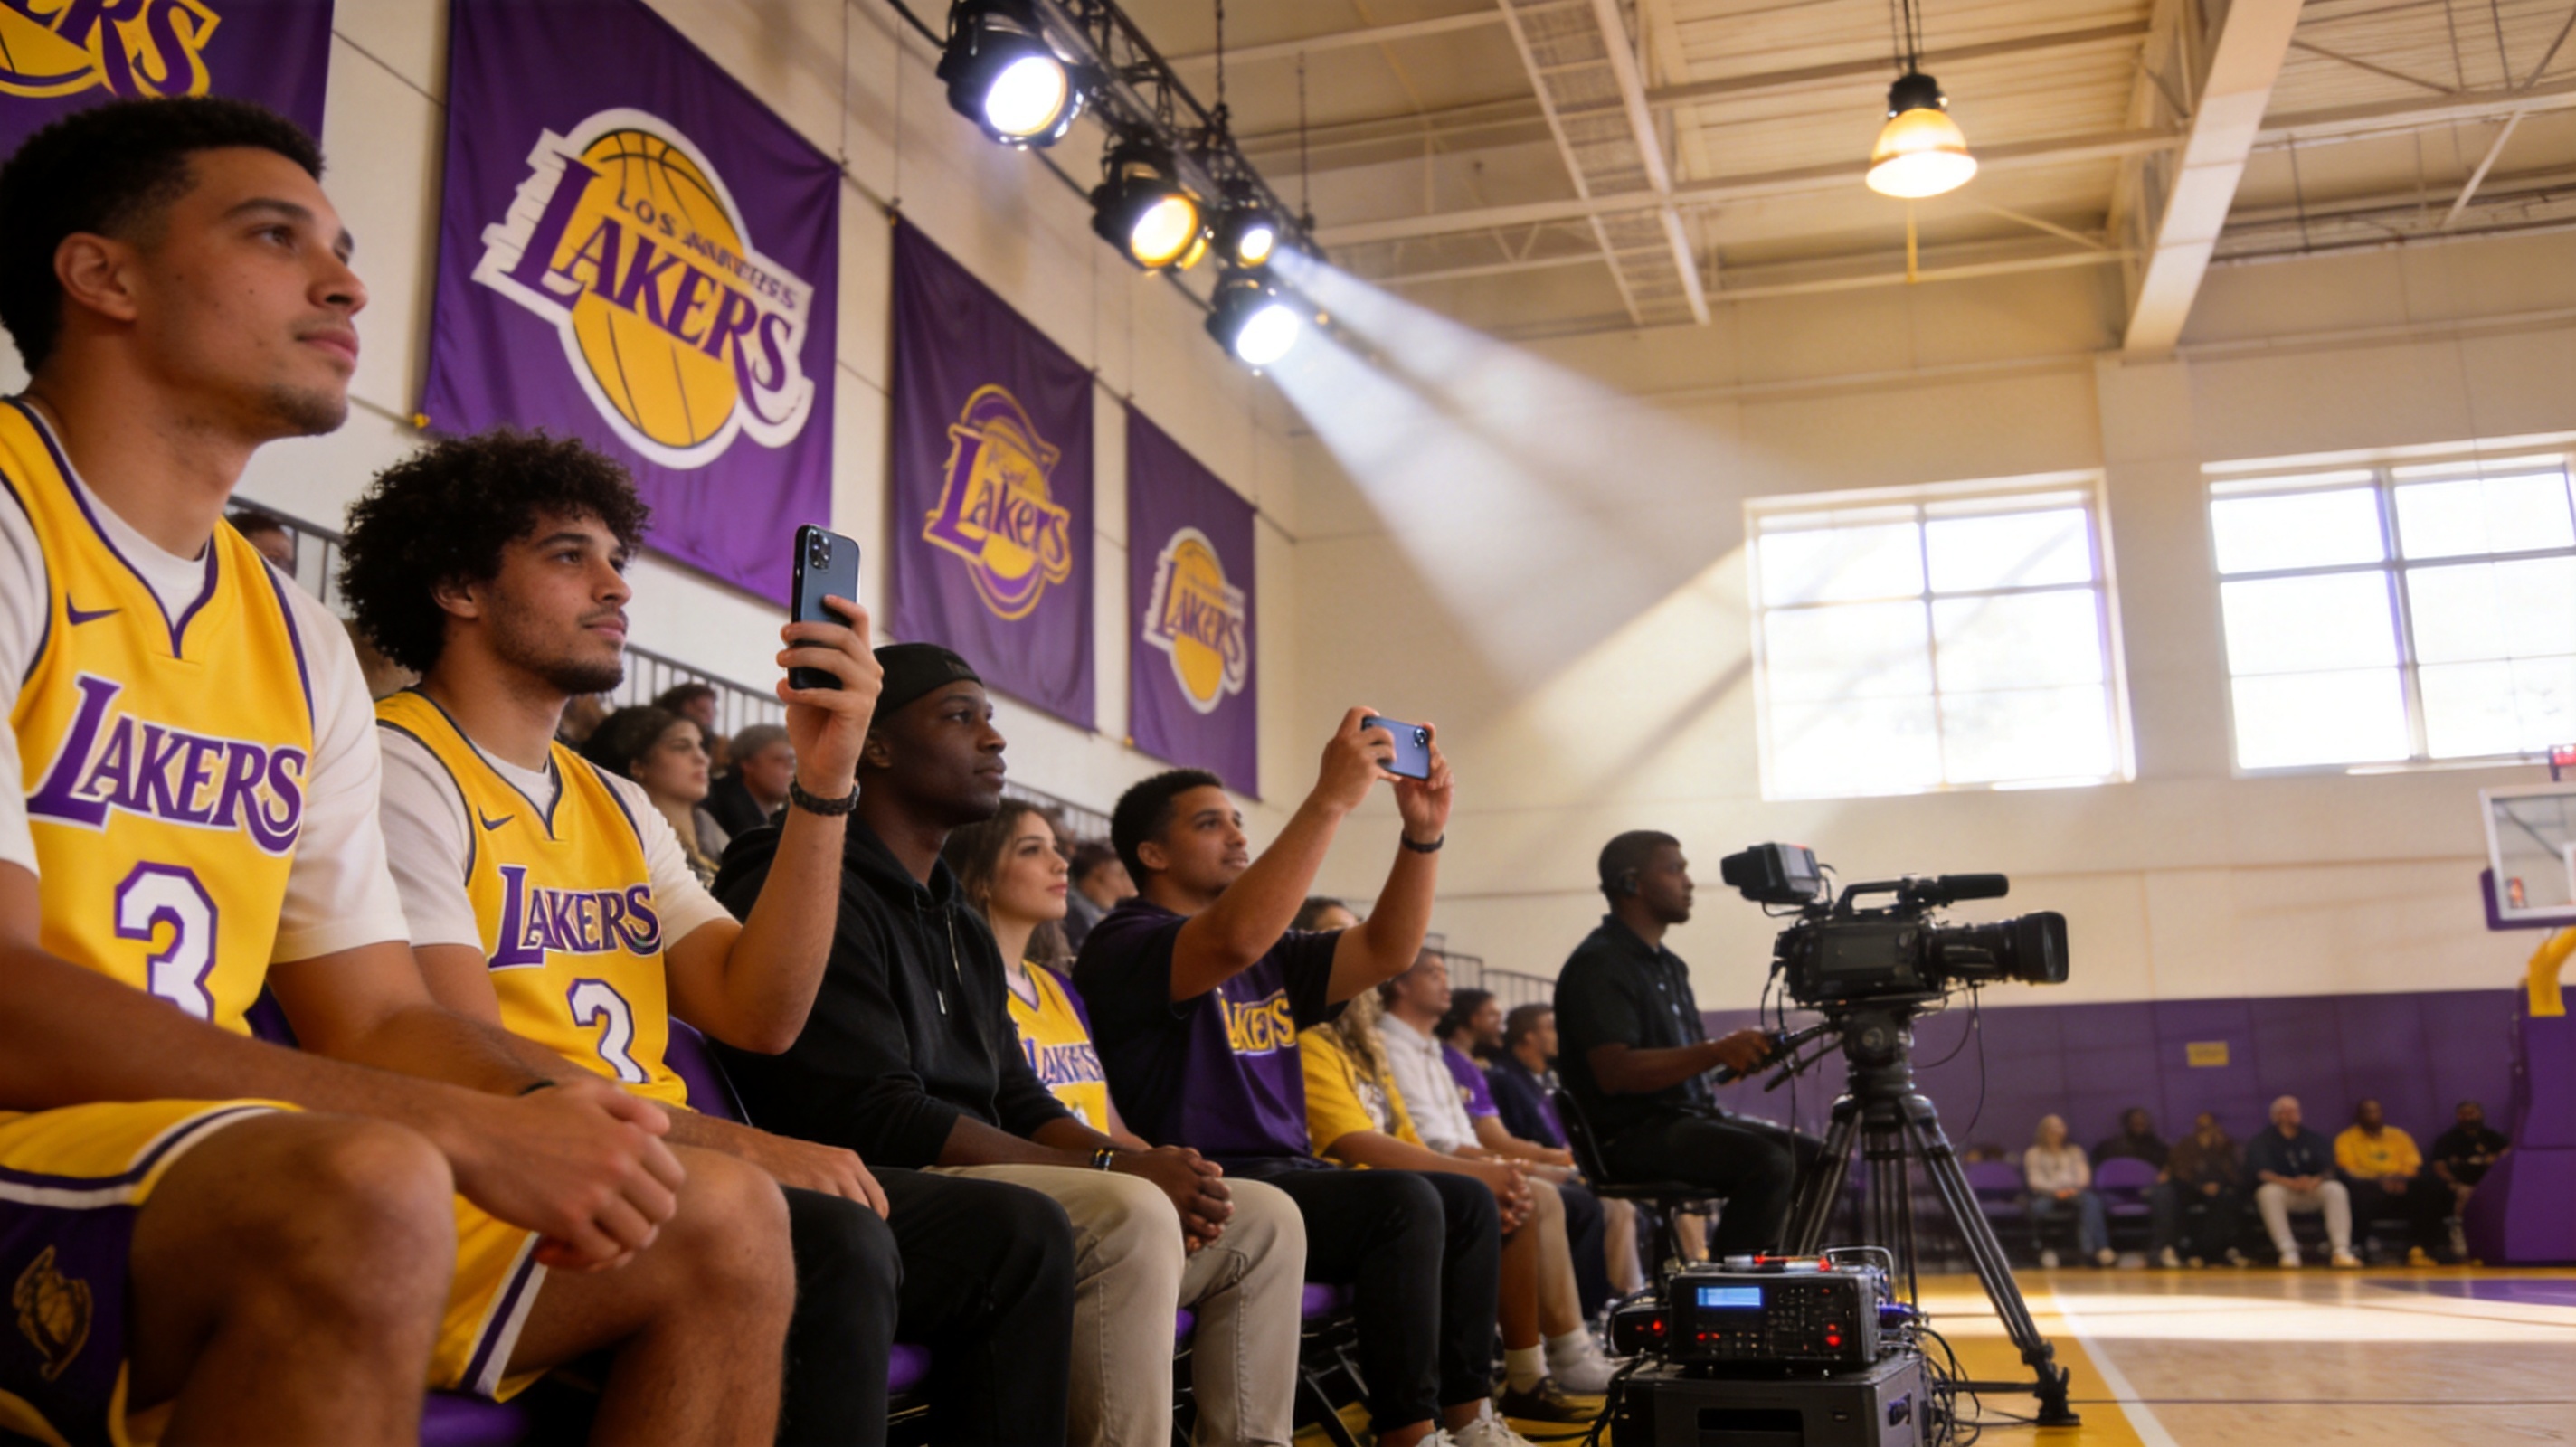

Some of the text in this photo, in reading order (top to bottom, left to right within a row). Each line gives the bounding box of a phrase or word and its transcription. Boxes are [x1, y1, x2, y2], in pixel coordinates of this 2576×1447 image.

[497, 150, 800, 426] LAKERS
[616, 187, 677, 238] LOS
[26, 672, 308, 856] LAKERS
[114, 859, 219, 1023] 3
[488, 865, 663, 971] LAKERS
